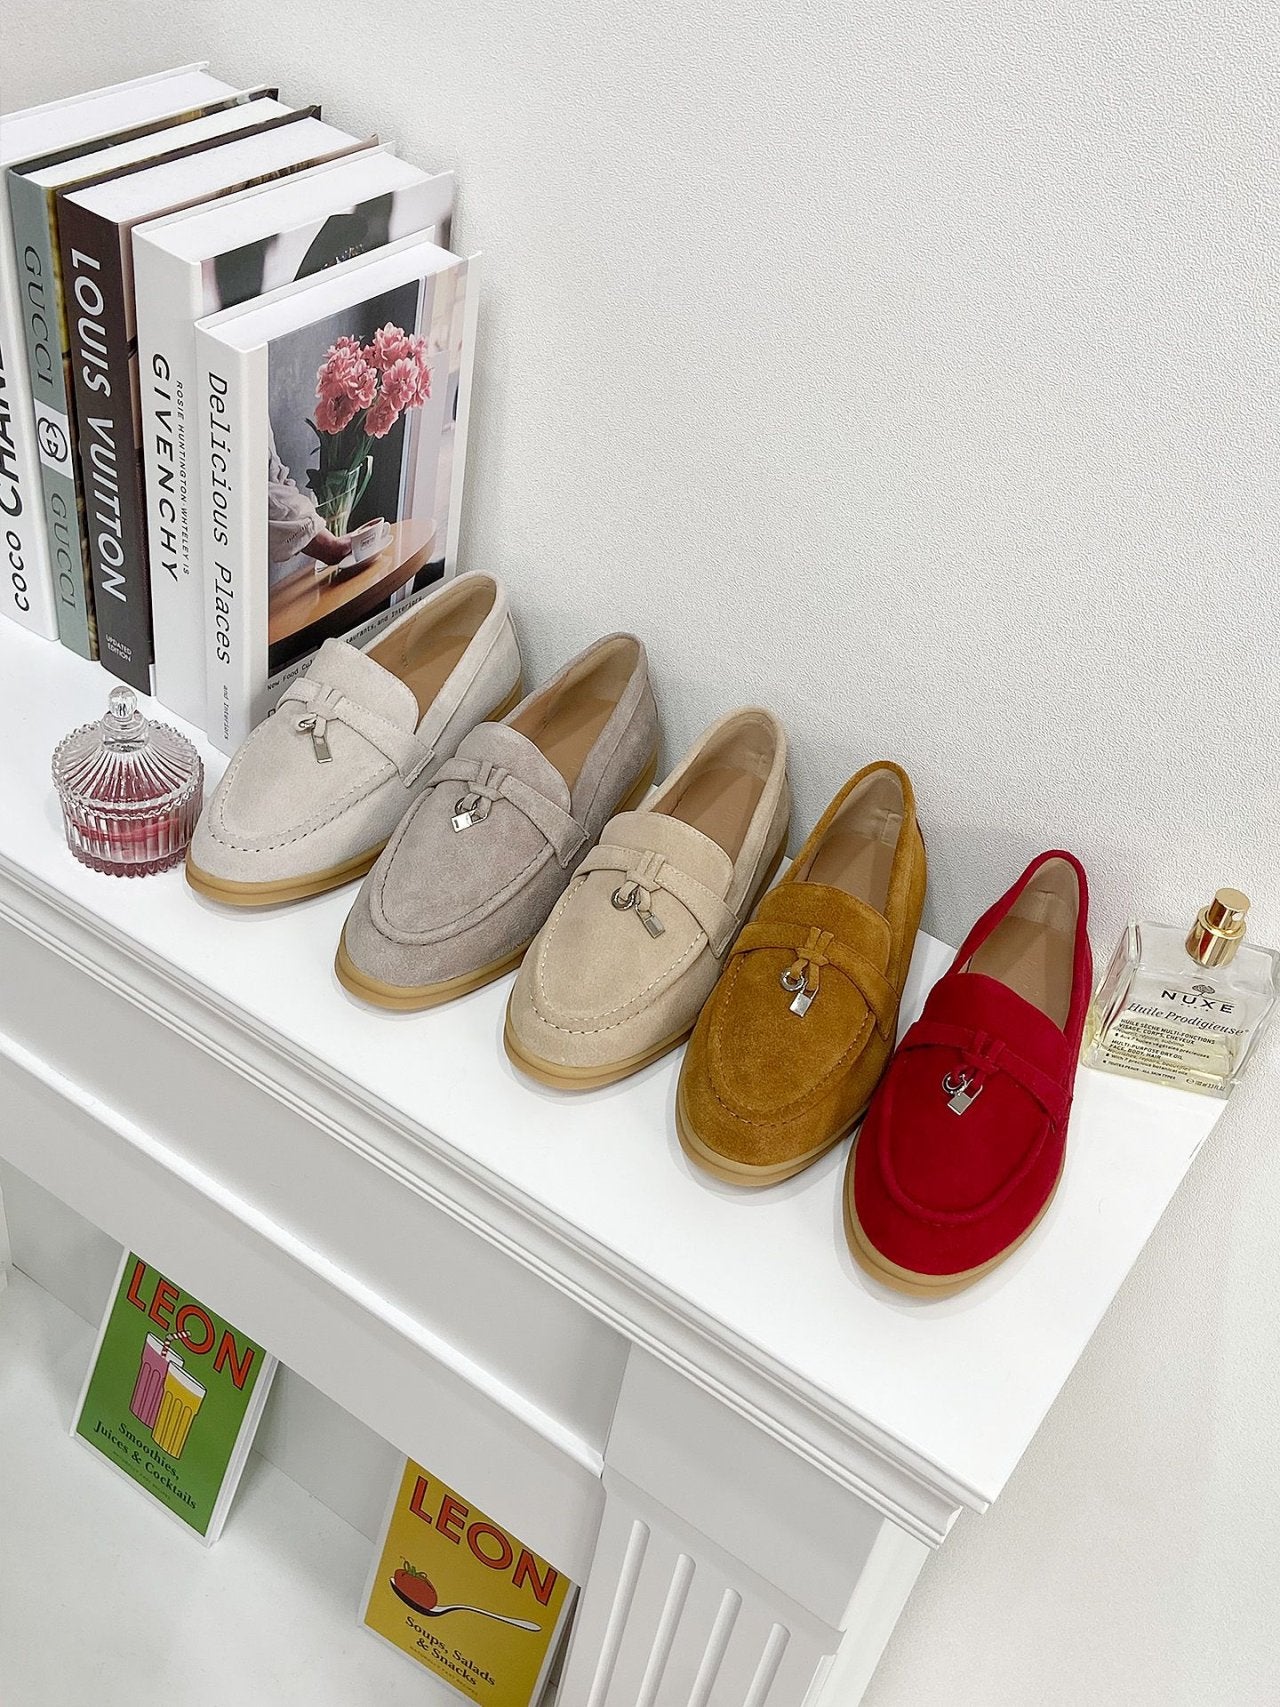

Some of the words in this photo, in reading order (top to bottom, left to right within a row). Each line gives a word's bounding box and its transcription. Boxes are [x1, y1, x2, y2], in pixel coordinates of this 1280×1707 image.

[24, 246, 54, 387] GUCCI
[71, 247, 111, 397] LOUIS
[152, 353, 179, 583] GIVENCHY
[176, 380, 184, 420] ROSIE
[183, 563, 189, 575] IS
[208, 372, 233, 546] Delicious
[50, 493, 76, 611] GUCCI
[86, 418, 128, 602] VUITTON
[6, 531, 30, 613] COCO
[213, 562, 234, 665] Places
[106, 633, 132, 655] UPDATED
[107, 642, 131, 662] EDITION
[267, 681, 280, 691] New
[283, 668, 299, 681] Food
[377, 616, 389, 625] and
[391, 597, 422, 617] Interiors
[1127, 1002, 1163, 1017] Huile
[1165, 1011, 1243, 1036] Prodigieuse
[1161, 990, 1235, 1014] NUXE
[1165, 1034, 1194, 1044] CHEVEUX
[127, 1260, 255, 1391] LEON
[94, 1421, 128, 1453] Juices
[131, 1450, 142, 1464] &
[145, 1461, 196, 1509] Cocktails
[119, 1422, 179, 1480] Smoothies,
[409, 1475, 558, 1607] LEON
[405, 1616, 448, 1653] Soups,
[452, 1650, 496, 1686] Salads
[416, 1638, 429, 1651] &
[431, 1648, 476, 1685] Snacks
